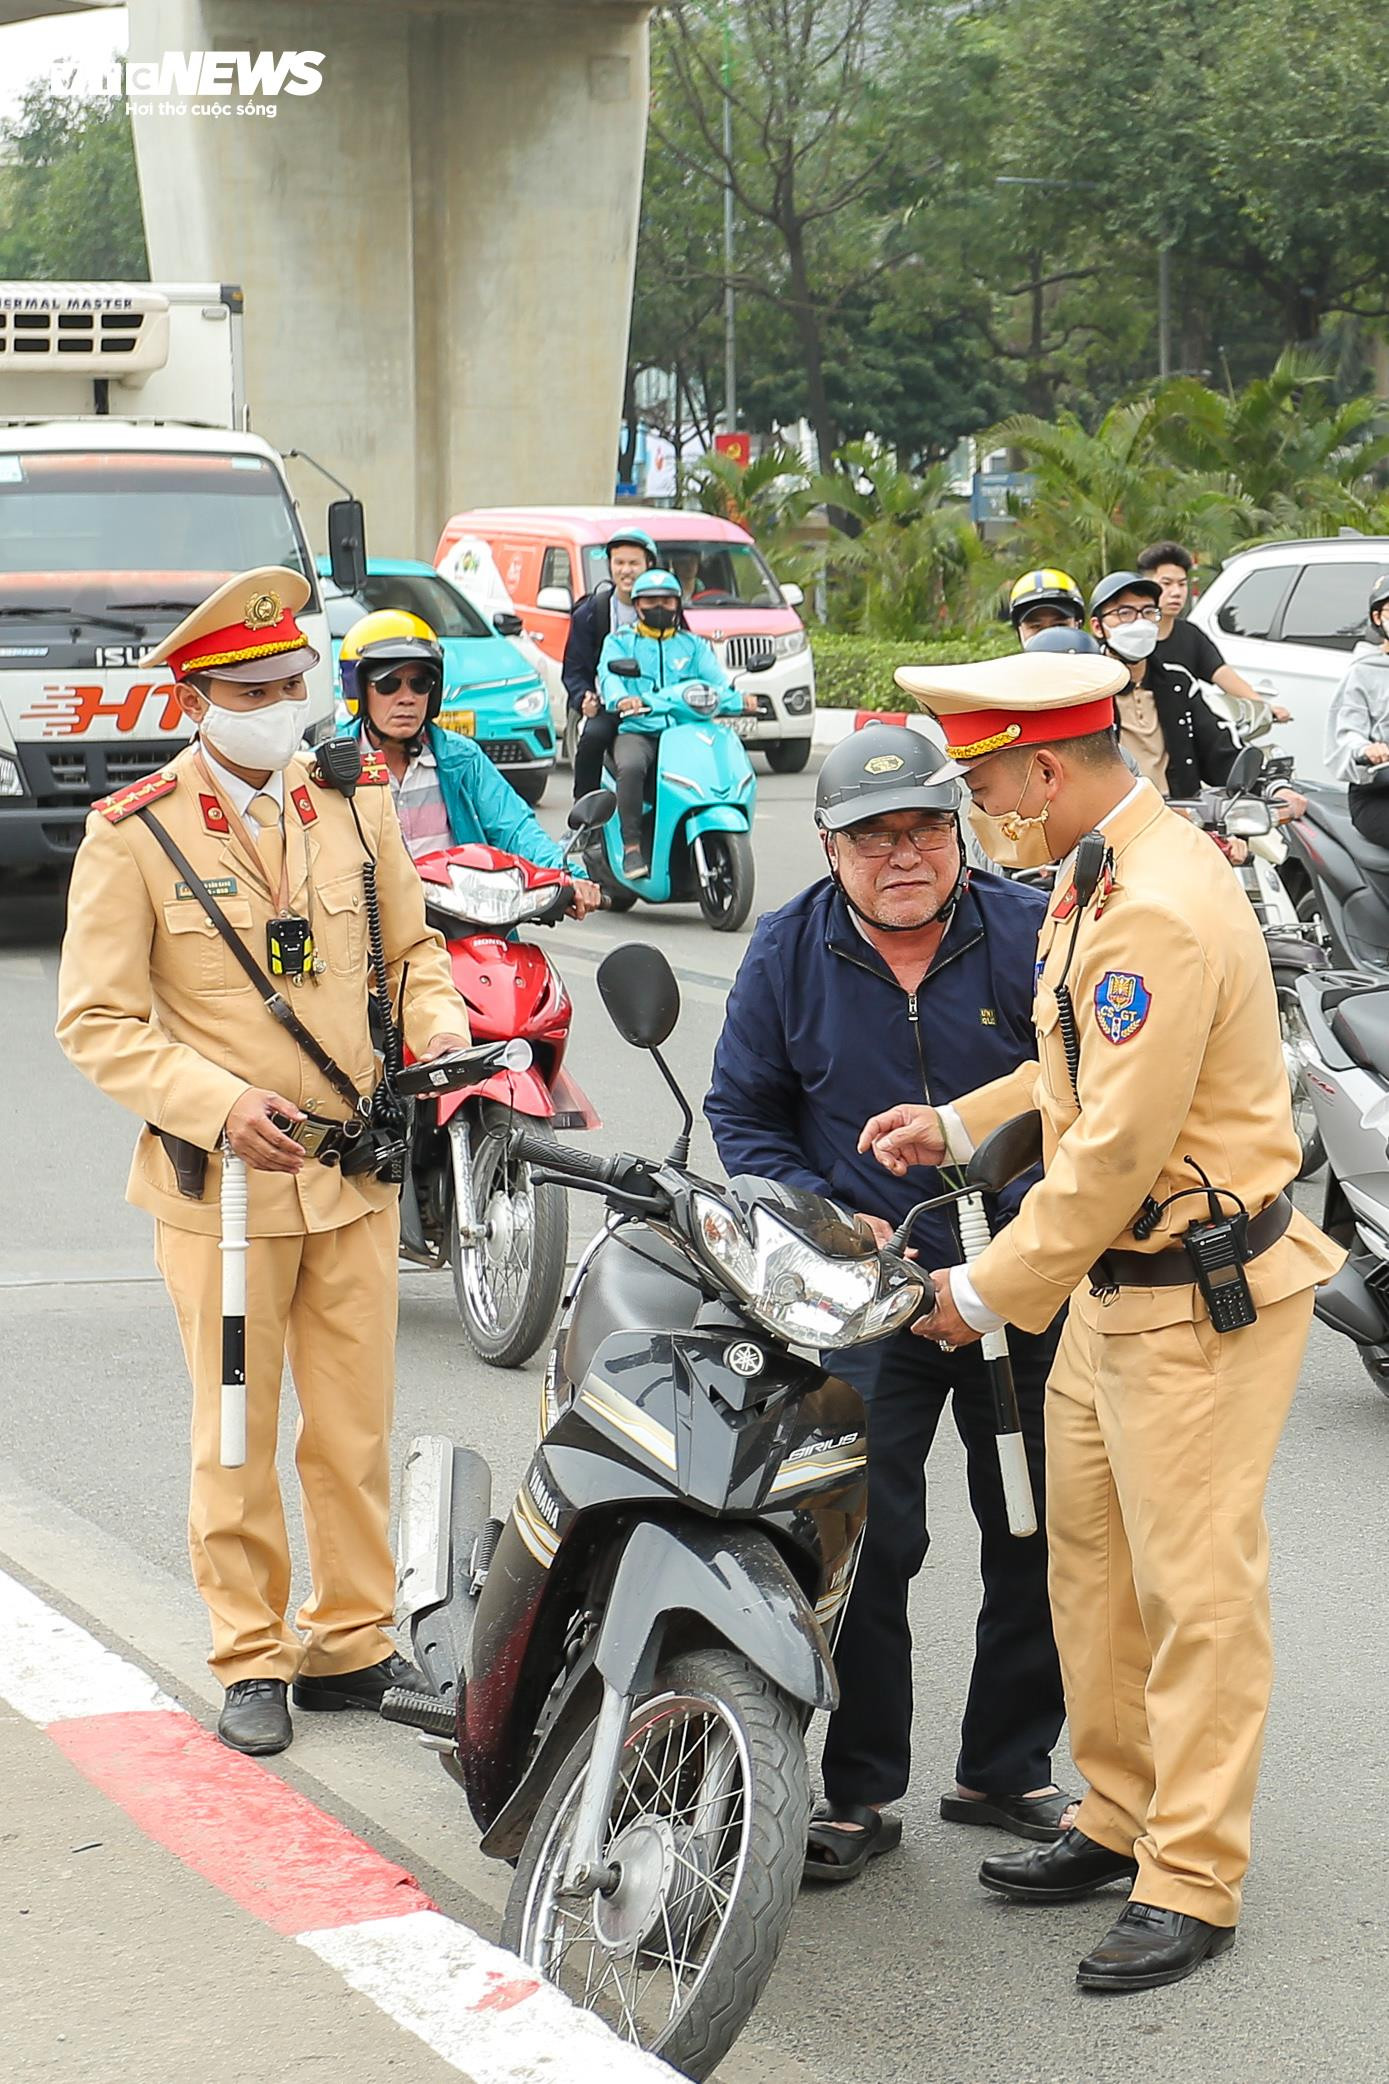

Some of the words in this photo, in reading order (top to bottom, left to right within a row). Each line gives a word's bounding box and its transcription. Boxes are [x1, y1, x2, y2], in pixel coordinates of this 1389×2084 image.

[66, 298, 133, 311] MASTER
[95, 647, 166, 667] ISU
[1100, 1005, 1115, 1018] CS
[1120, 1010, 1137, 1021] GT
[788, 1432, 859, 1462] SIRIUS
[529, 1466, 560, 1530] YAMAHA
